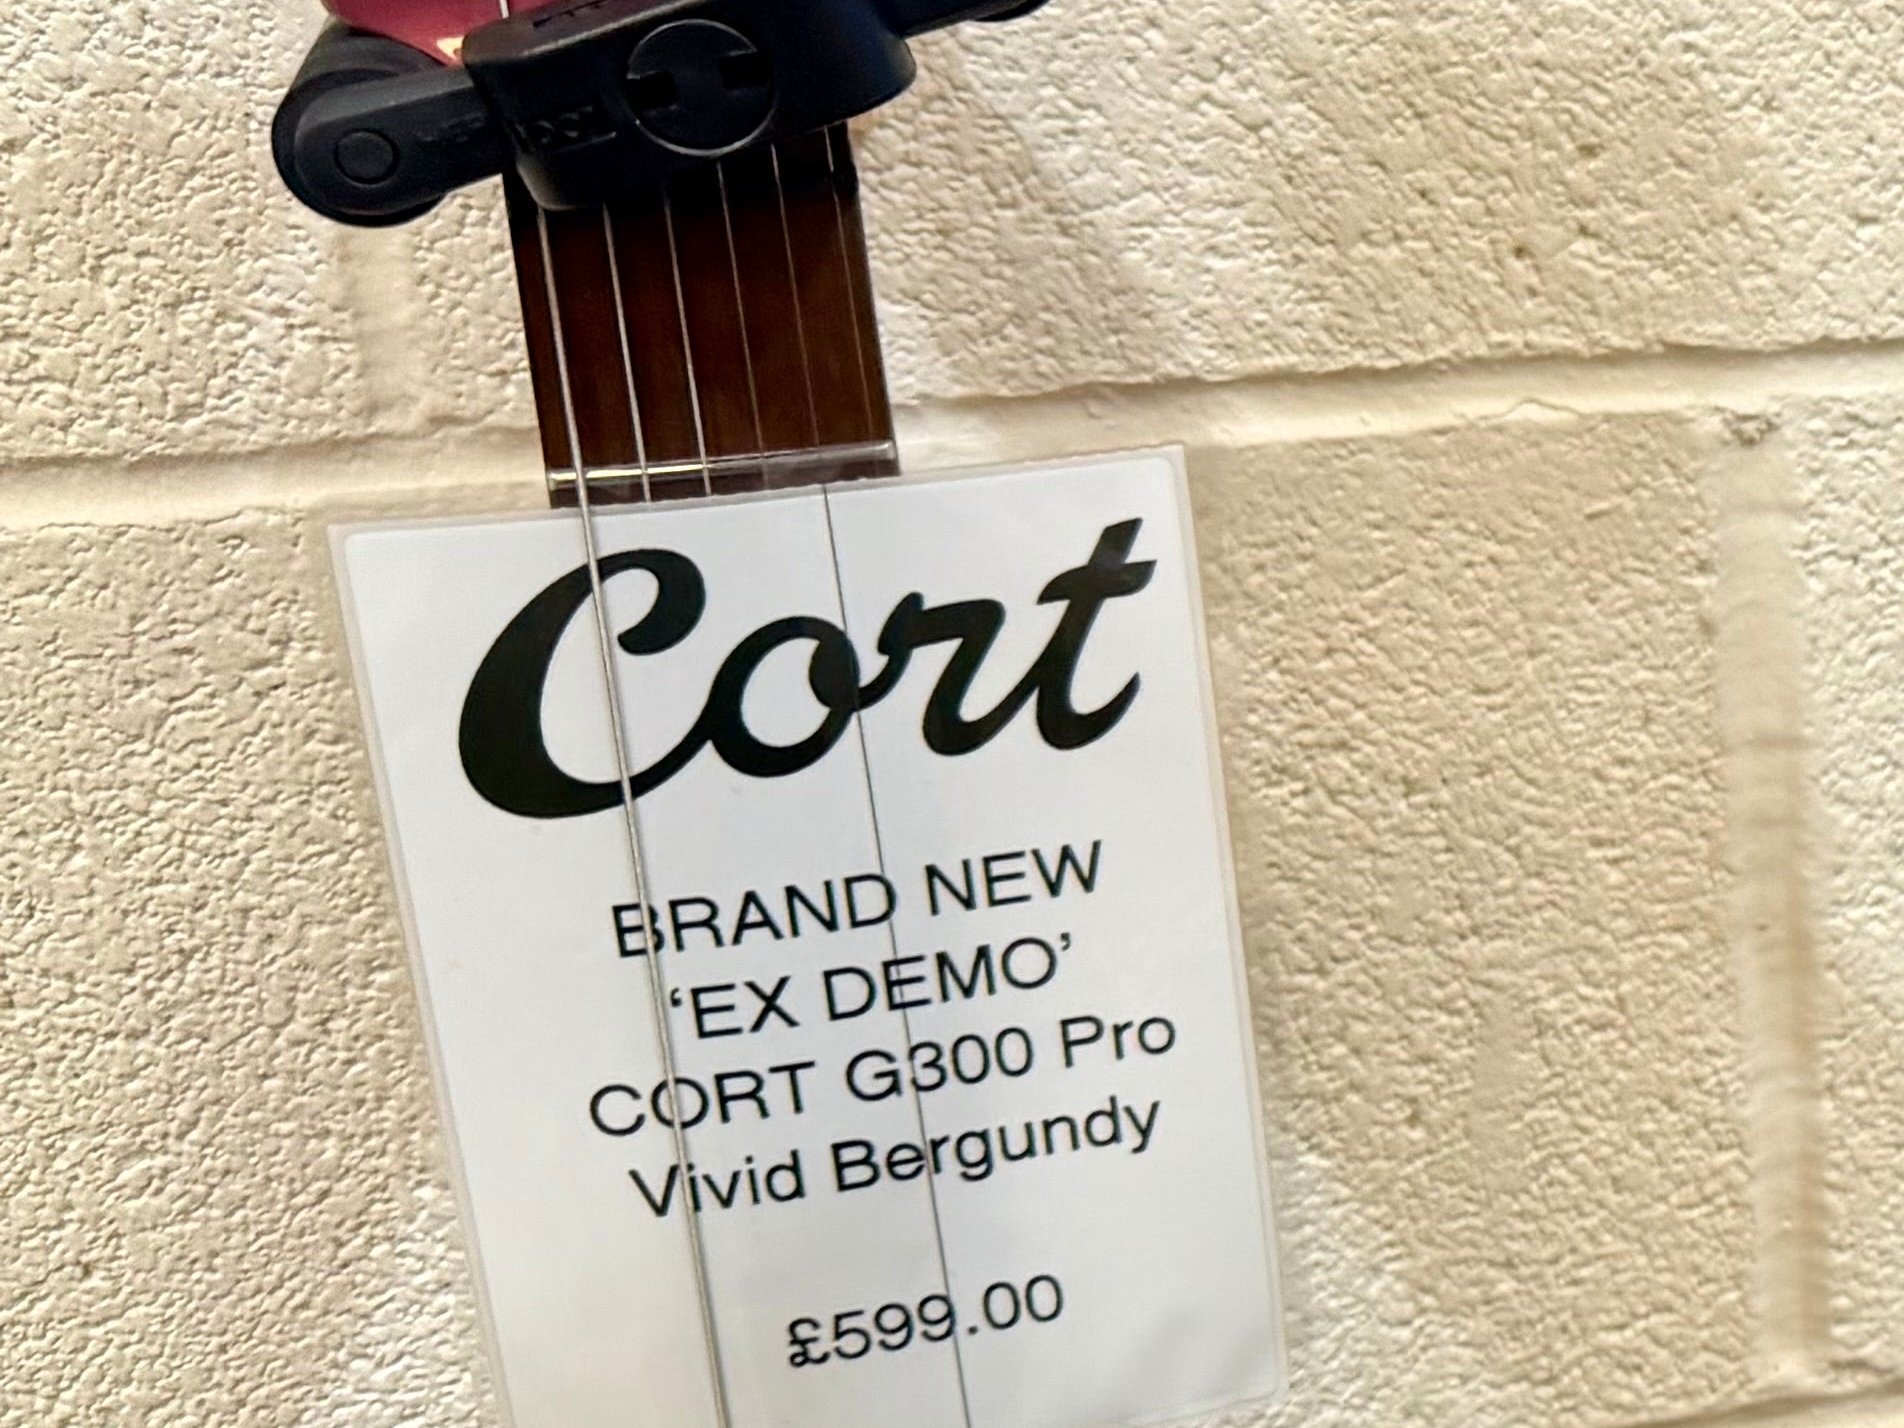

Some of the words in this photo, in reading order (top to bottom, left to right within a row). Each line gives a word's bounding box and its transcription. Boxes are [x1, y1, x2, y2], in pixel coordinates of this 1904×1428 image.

[457, 516, 1159, 819] Cort
[611, 870, 898, 960] BRAND
[925, 839, 1103, 917] NEW
[588, 1060, 817, 1138] CORT
[844, 1028, 1034, 1107] G300
[1061, 1009, 1178, 1069] Pro
[629, 1162, 804, 1219] Vivid
[831, 1094, 1163, 1193] Bergundy
[785, 1273, 1065, 1368] £599.00
